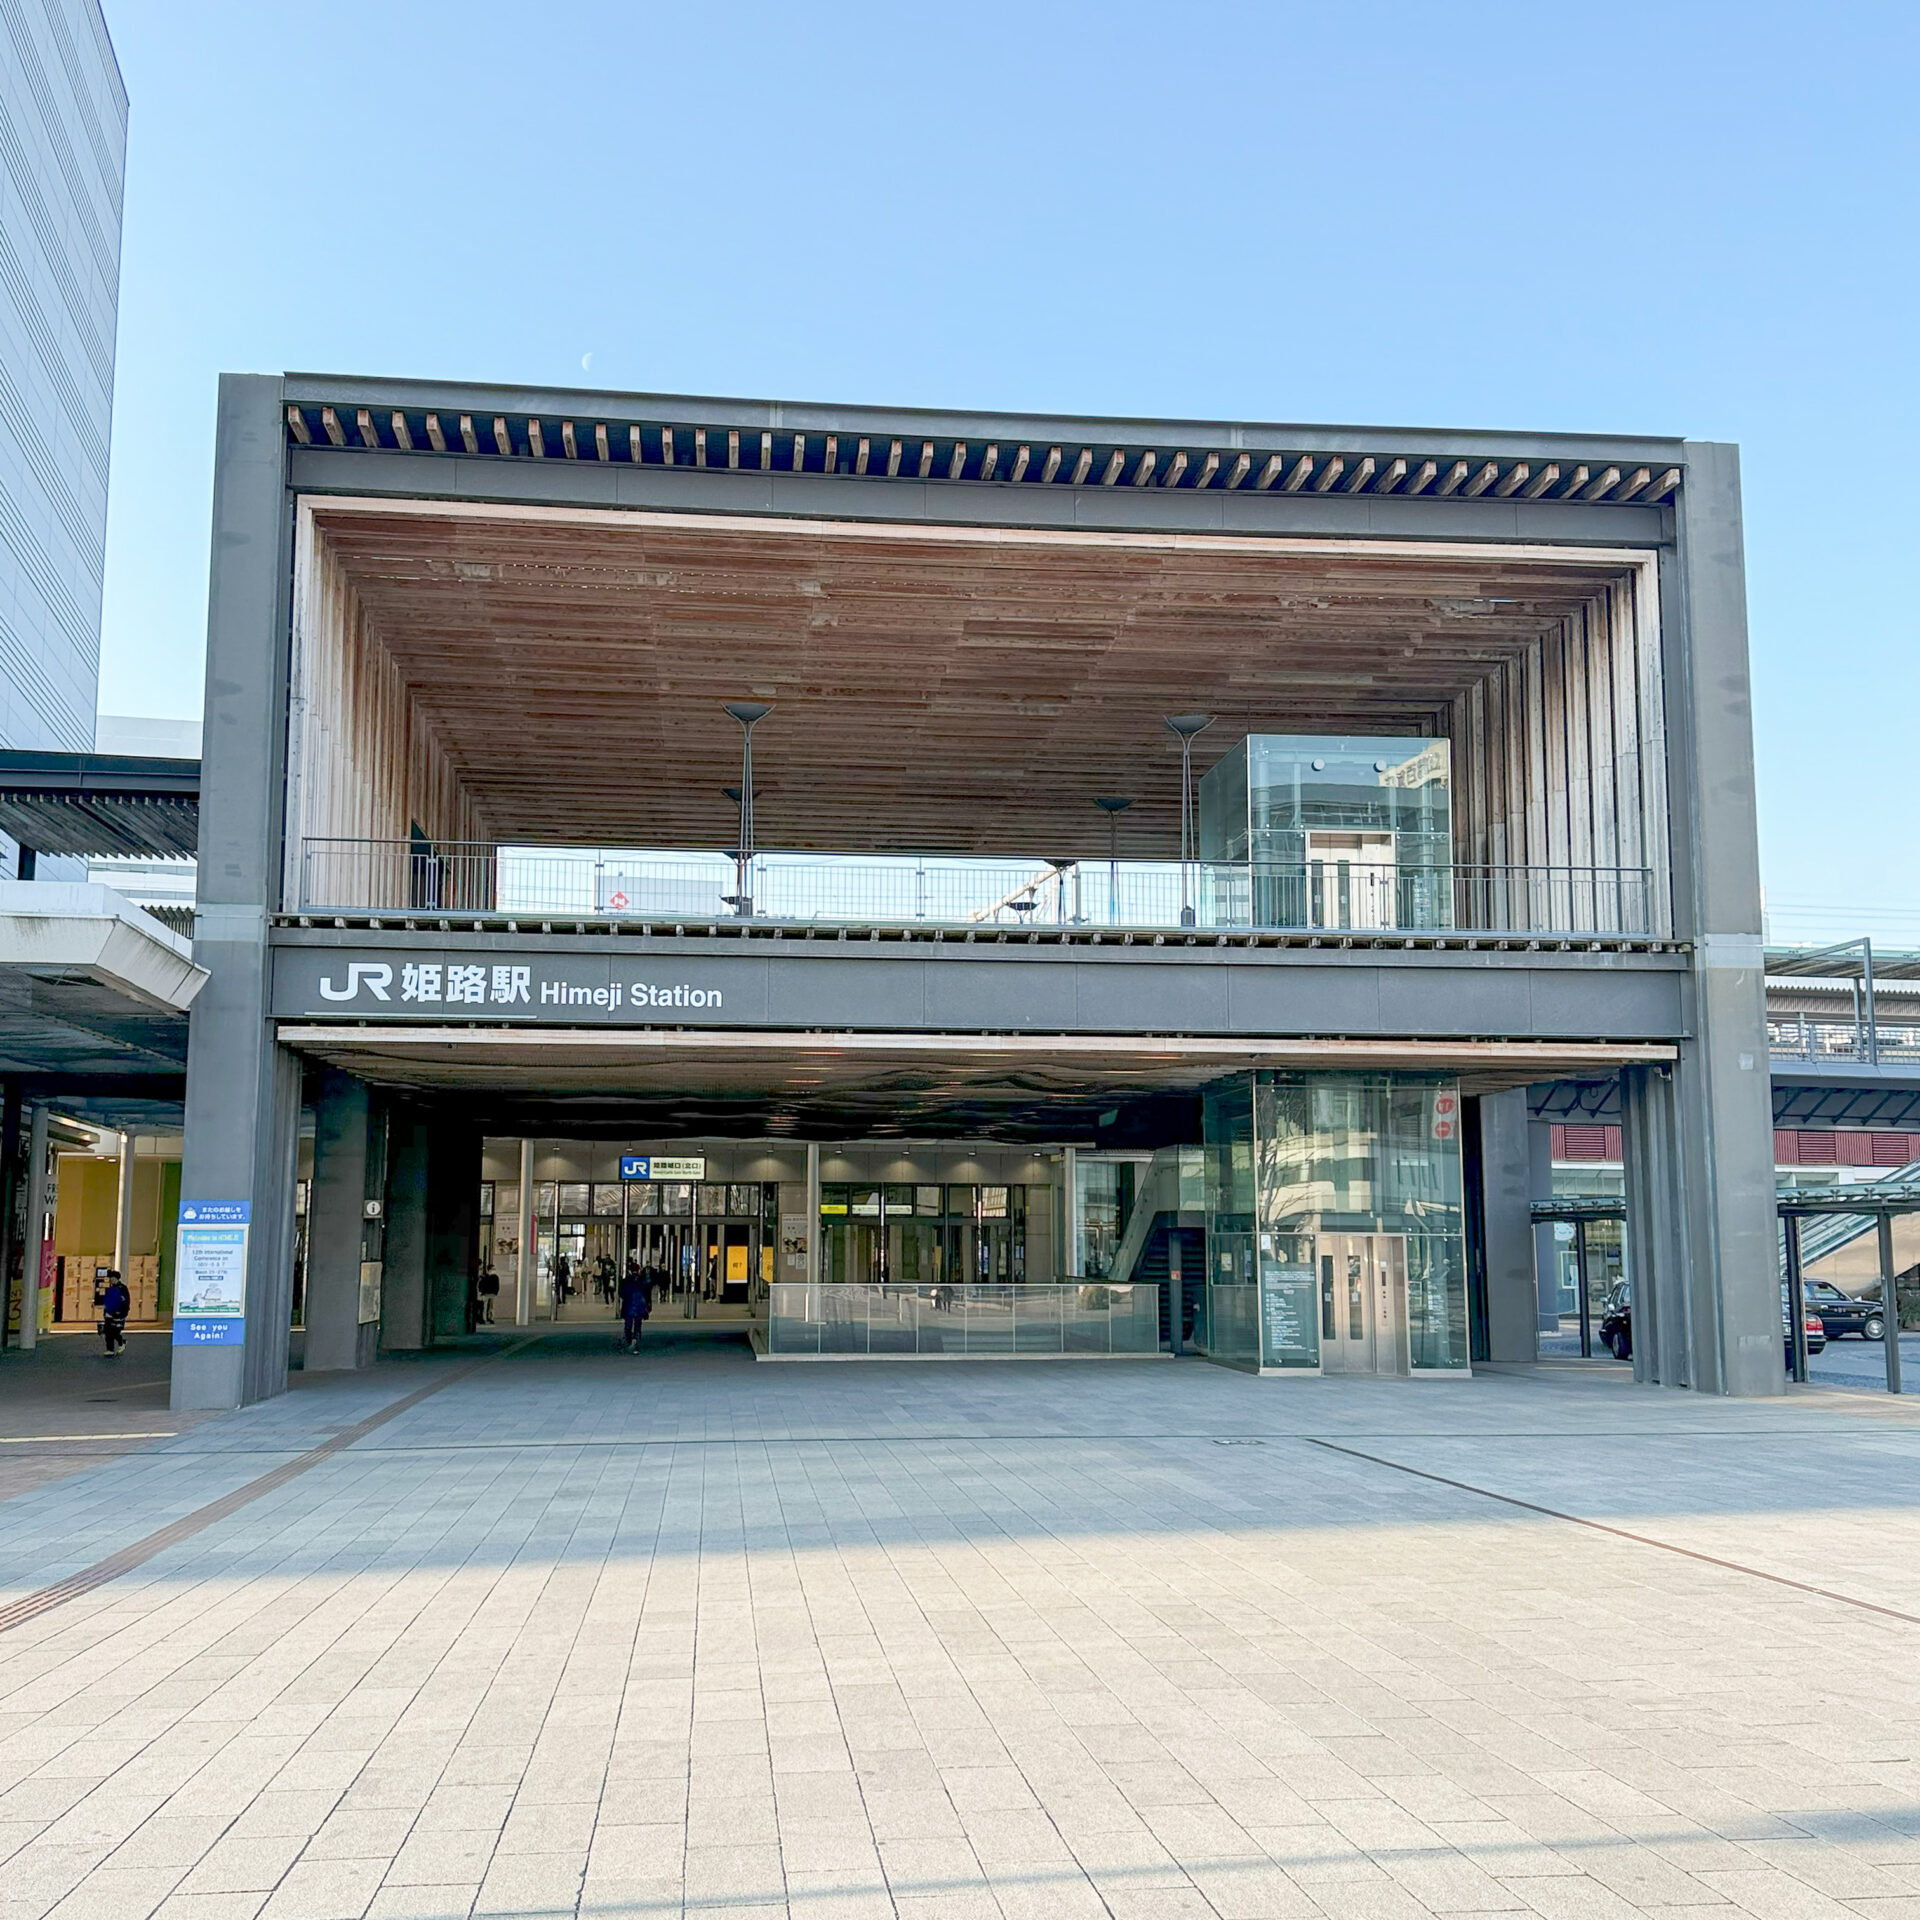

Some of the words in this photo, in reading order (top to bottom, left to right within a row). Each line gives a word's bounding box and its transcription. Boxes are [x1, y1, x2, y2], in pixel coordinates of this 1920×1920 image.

[319, 962, 393, 1001] JR
[400, 962, 531, 1004] 姫路駅
[540, 981, 622, 1012] Himeji
[630, 983, 723, 1008] Station
[624, 1161, 647, 1175] JR
[190, 1323, 207, 1331] See
[212, 1324, 228, 1332] you
[194, 1332, 224, 1341] Again!
